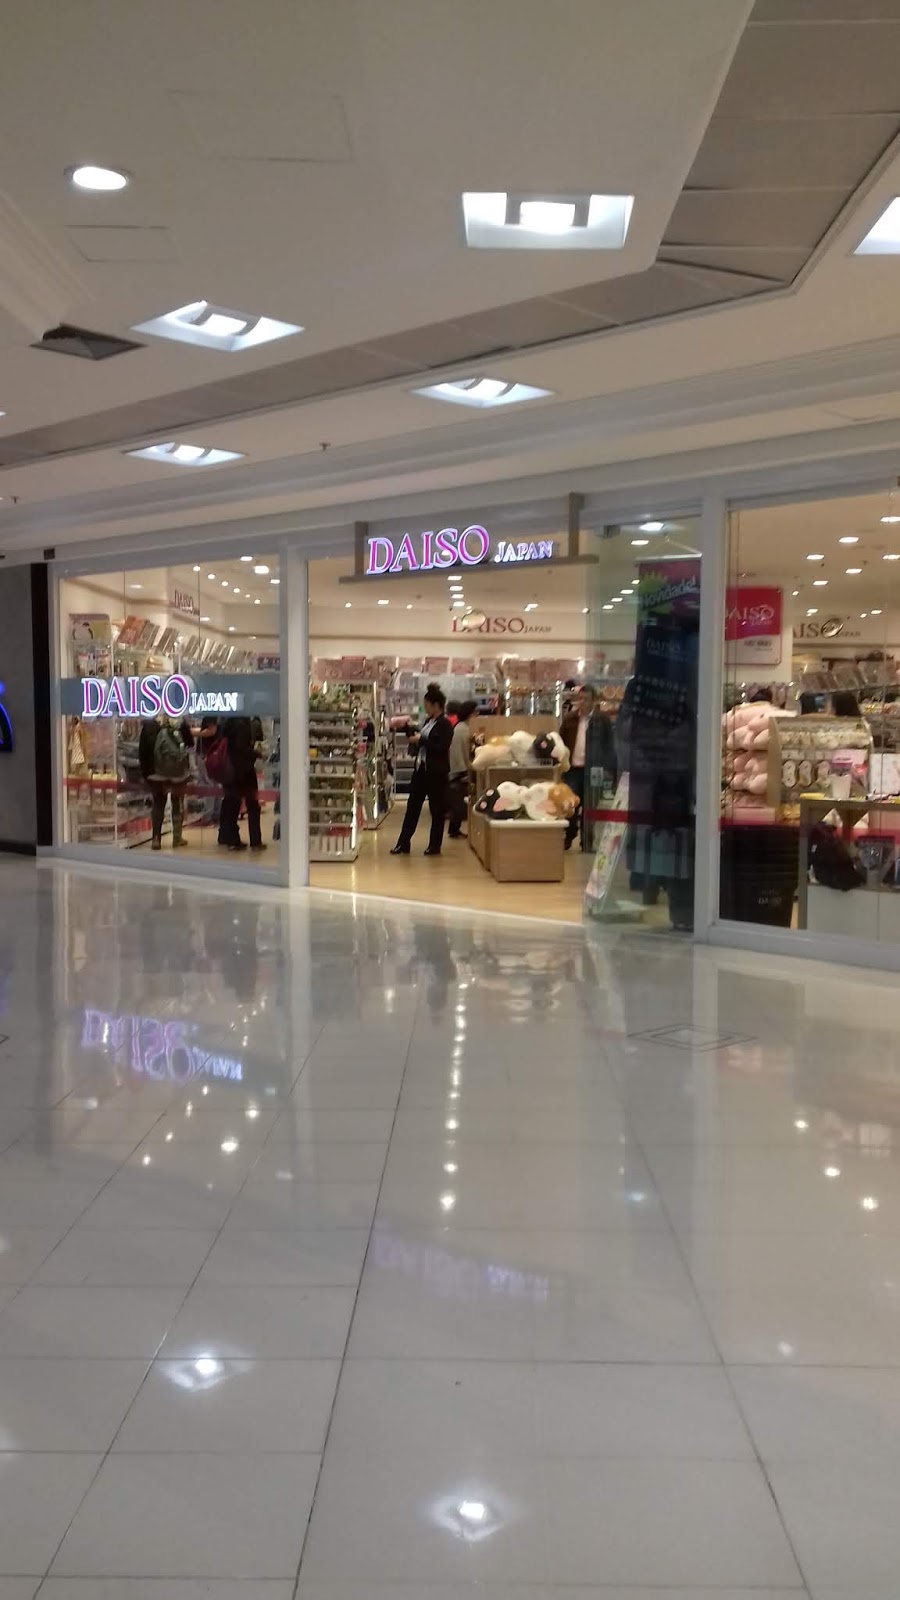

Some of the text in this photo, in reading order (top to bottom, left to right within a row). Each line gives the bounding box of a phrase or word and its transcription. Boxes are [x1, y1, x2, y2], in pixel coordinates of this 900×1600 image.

[366, 525, 553, 574] DAISO JAPAN
[524, 625, 552, 634] JAPAN
[81, 674, 239, 718] DAISO JAPAN
